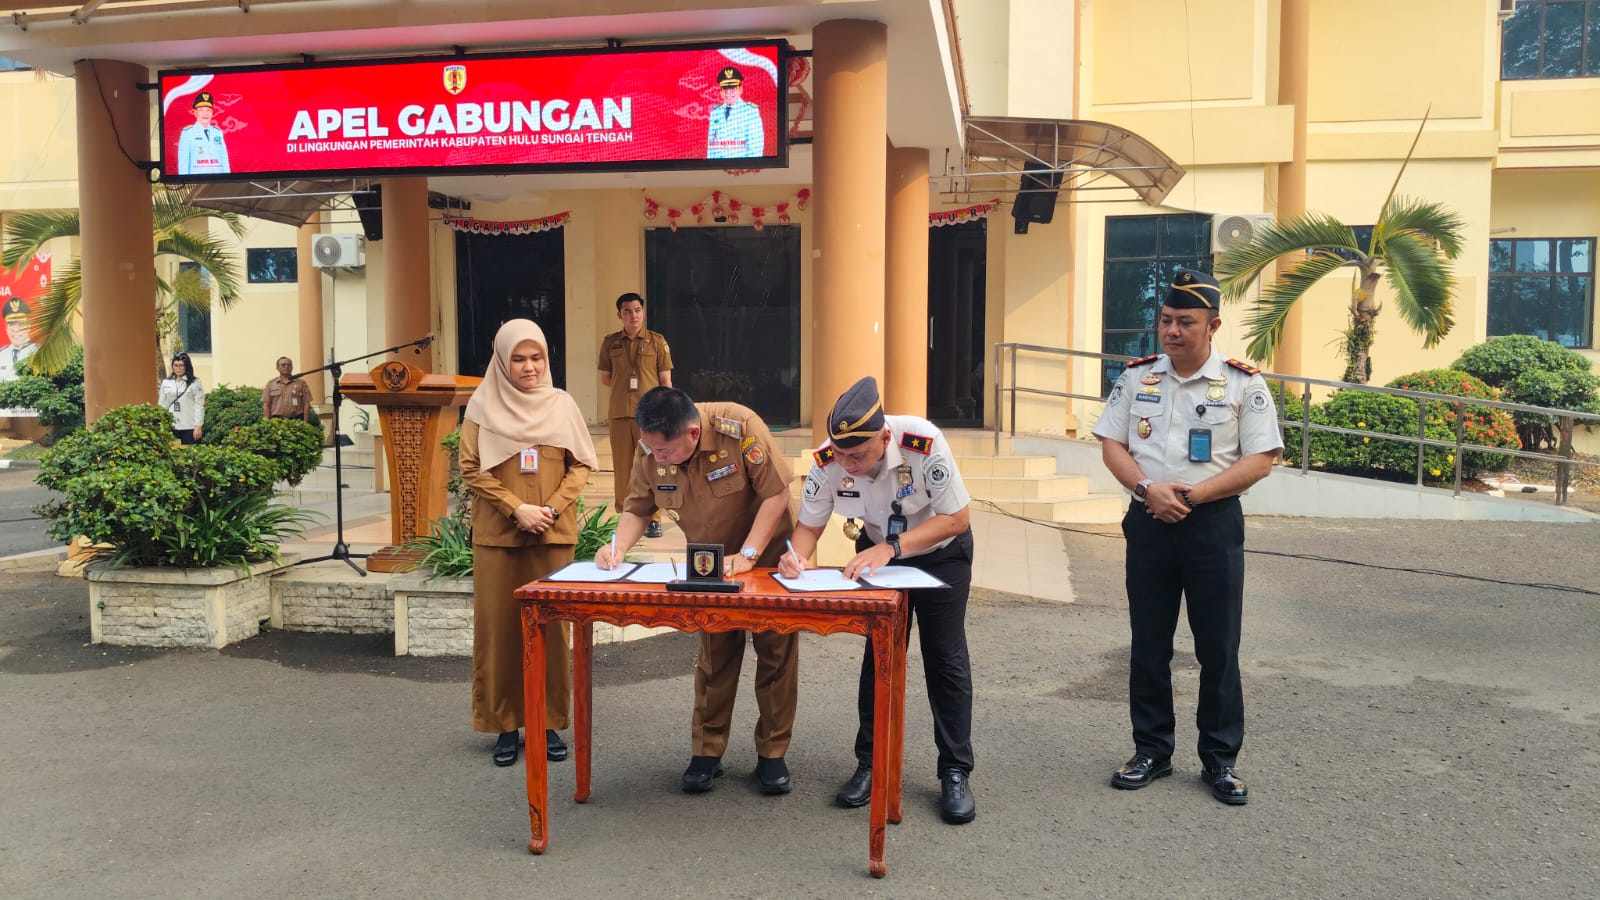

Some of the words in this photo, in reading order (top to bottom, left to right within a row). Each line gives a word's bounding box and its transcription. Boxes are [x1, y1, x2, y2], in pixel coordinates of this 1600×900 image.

[287, 106, 389, 141] APEL
[398, 97, 632, 136] GABUNGAN
[287, 143, 297, 153] DI
[299, 140, 368, 152] LINGKUNGAN
[370, 138, 439, 149] PEMERINTAH
[441, 135, 507, 147] KABUPATEN
[509, 134, 539, 145] HULU
[541, 133, 584, 144] SUNGAI
[586, 132, 633, 143] TENGAH
[443, 215, 529, 232] DIRGAHAYU
